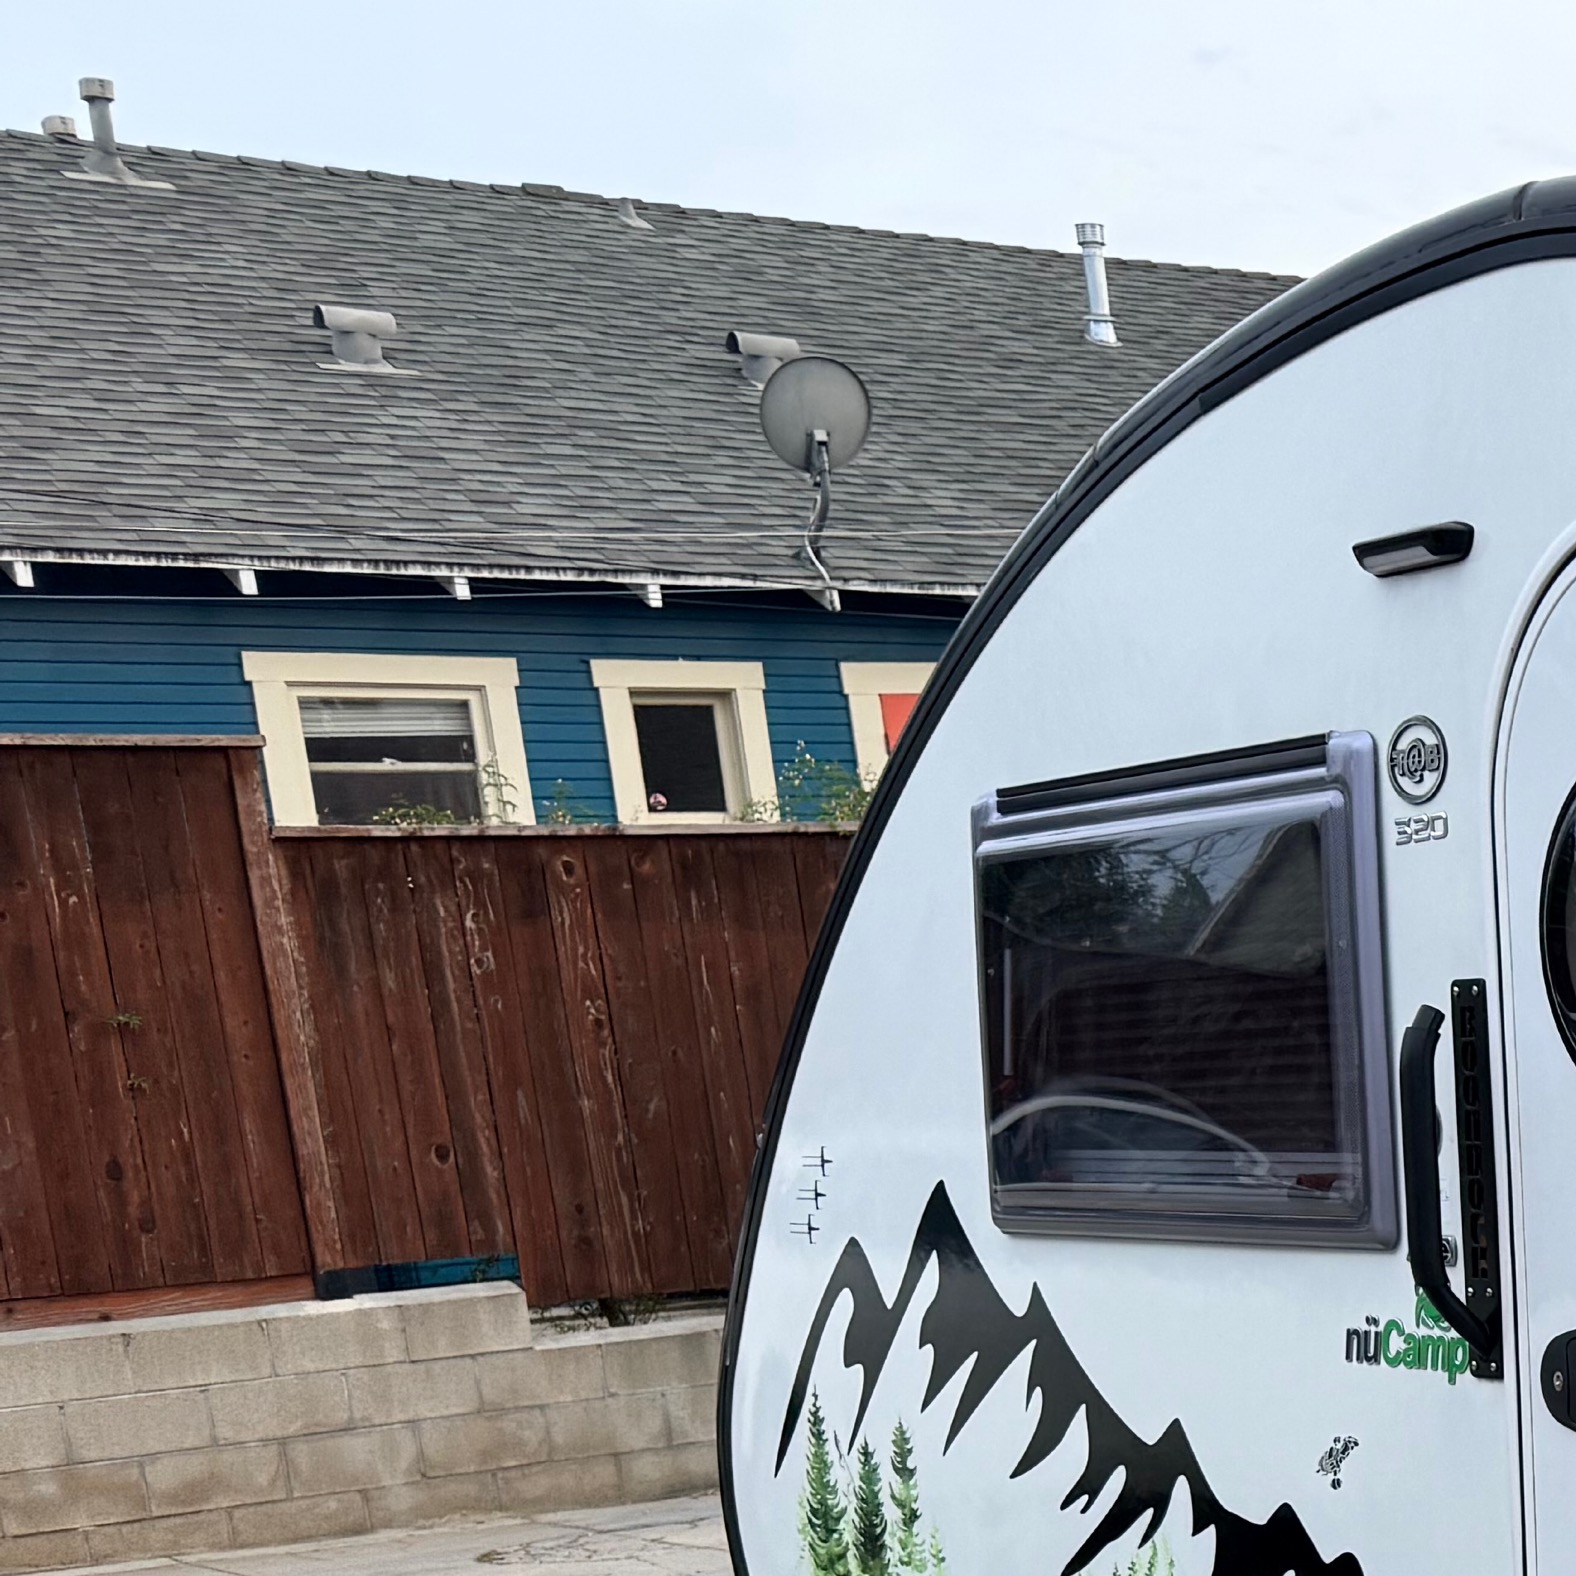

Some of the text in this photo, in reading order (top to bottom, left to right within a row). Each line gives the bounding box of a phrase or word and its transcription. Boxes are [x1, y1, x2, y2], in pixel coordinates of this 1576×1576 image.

[1392, 738, 1441, 783] T@B
[1394, 810, 1449, 845] 320
[1345, 1315, 1469, 1385] nüCamp
